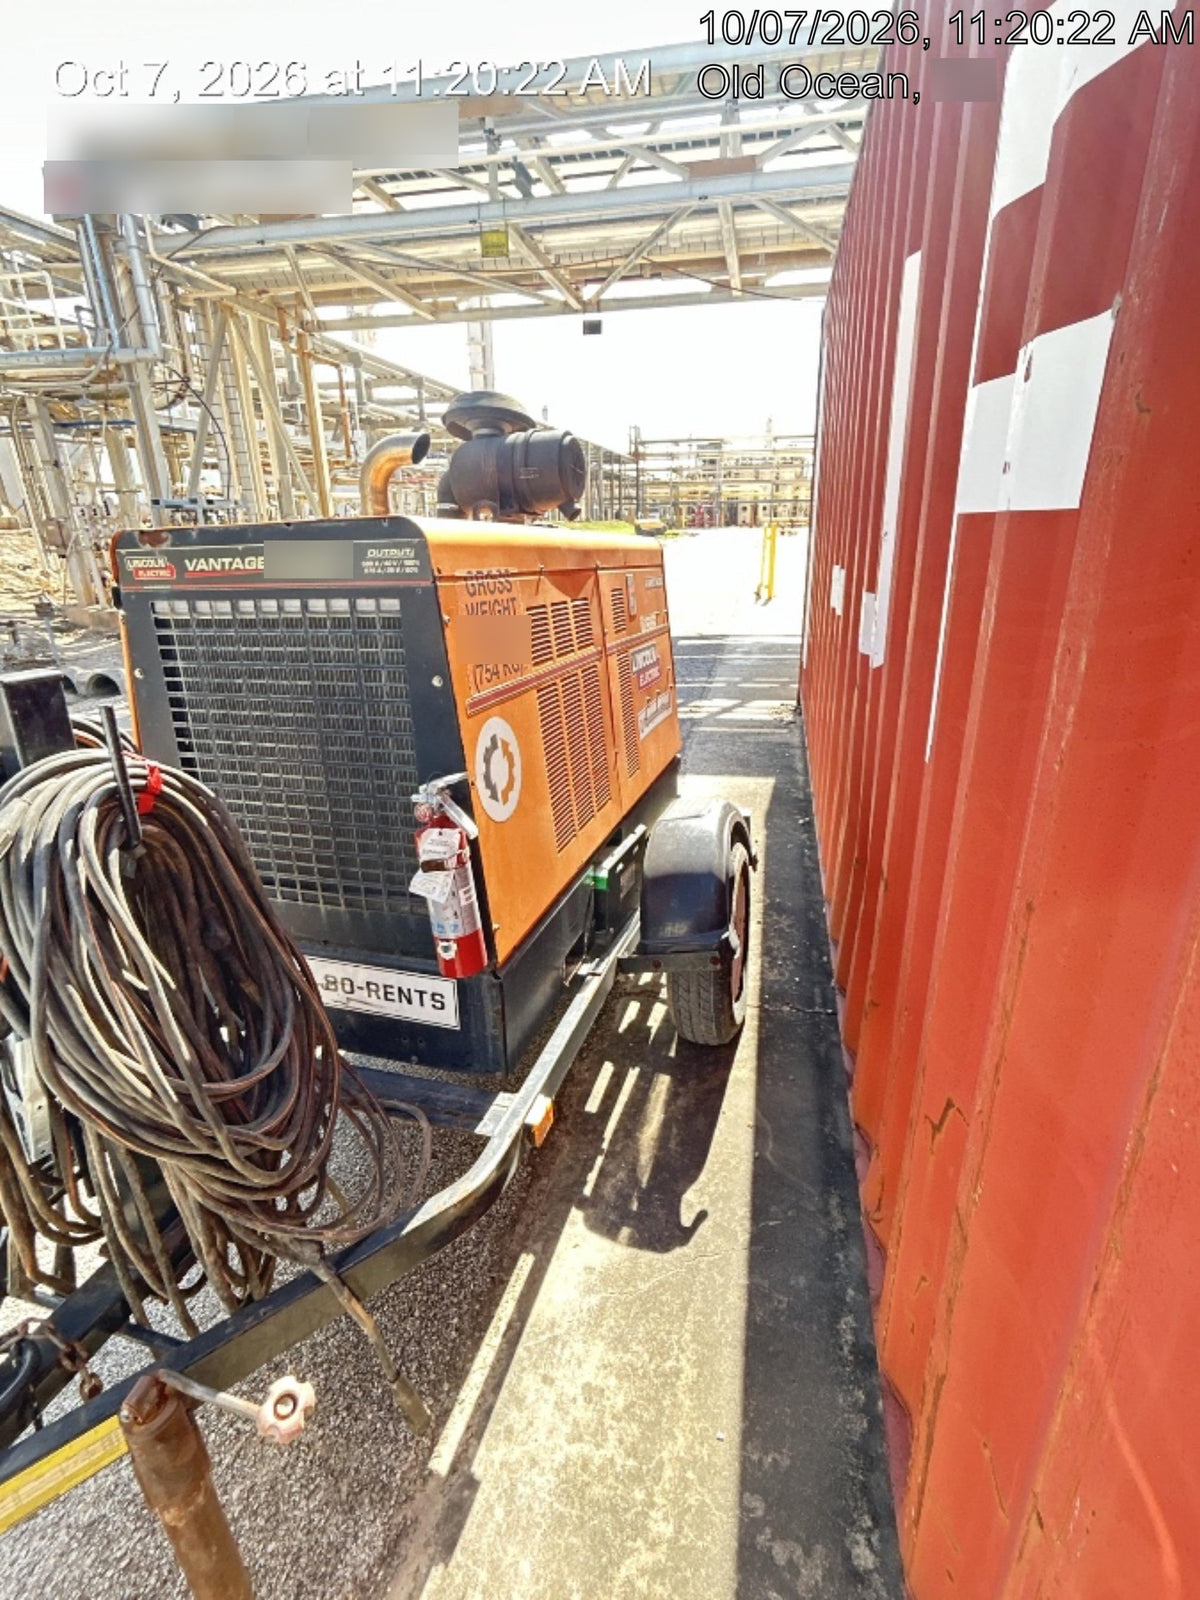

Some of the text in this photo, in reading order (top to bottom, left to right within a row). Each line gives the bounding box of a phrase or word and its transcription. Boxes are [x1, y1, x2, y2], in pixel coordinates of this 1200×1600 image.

[184, 556, 265, 572] VANTAGE
[464, 568, 513, 598] GROSS
[465, 597, 517, 616] WEIGHT
